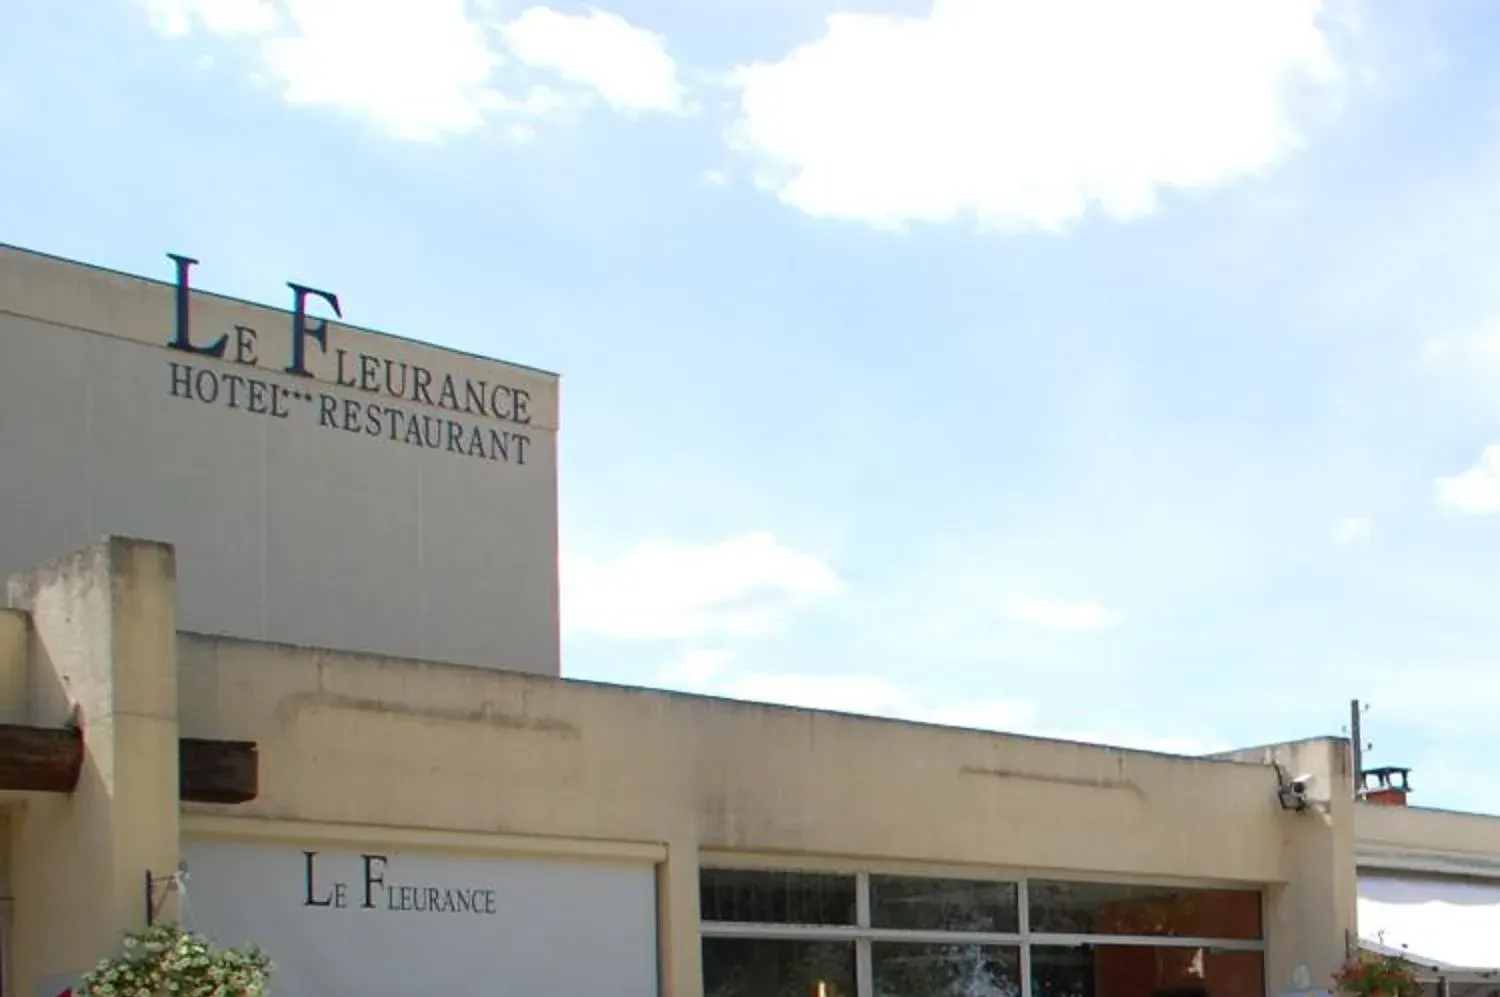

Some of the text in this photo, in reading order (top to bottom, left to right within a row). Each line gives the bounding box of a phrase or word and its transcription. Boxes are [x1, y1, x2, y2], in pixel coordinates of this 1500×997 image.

[285, 281, 532, 425] FLEURANCE
[319, 394, 531, 465] RESTAURANT
[360, 854, 497, 914] FLEURANCE
